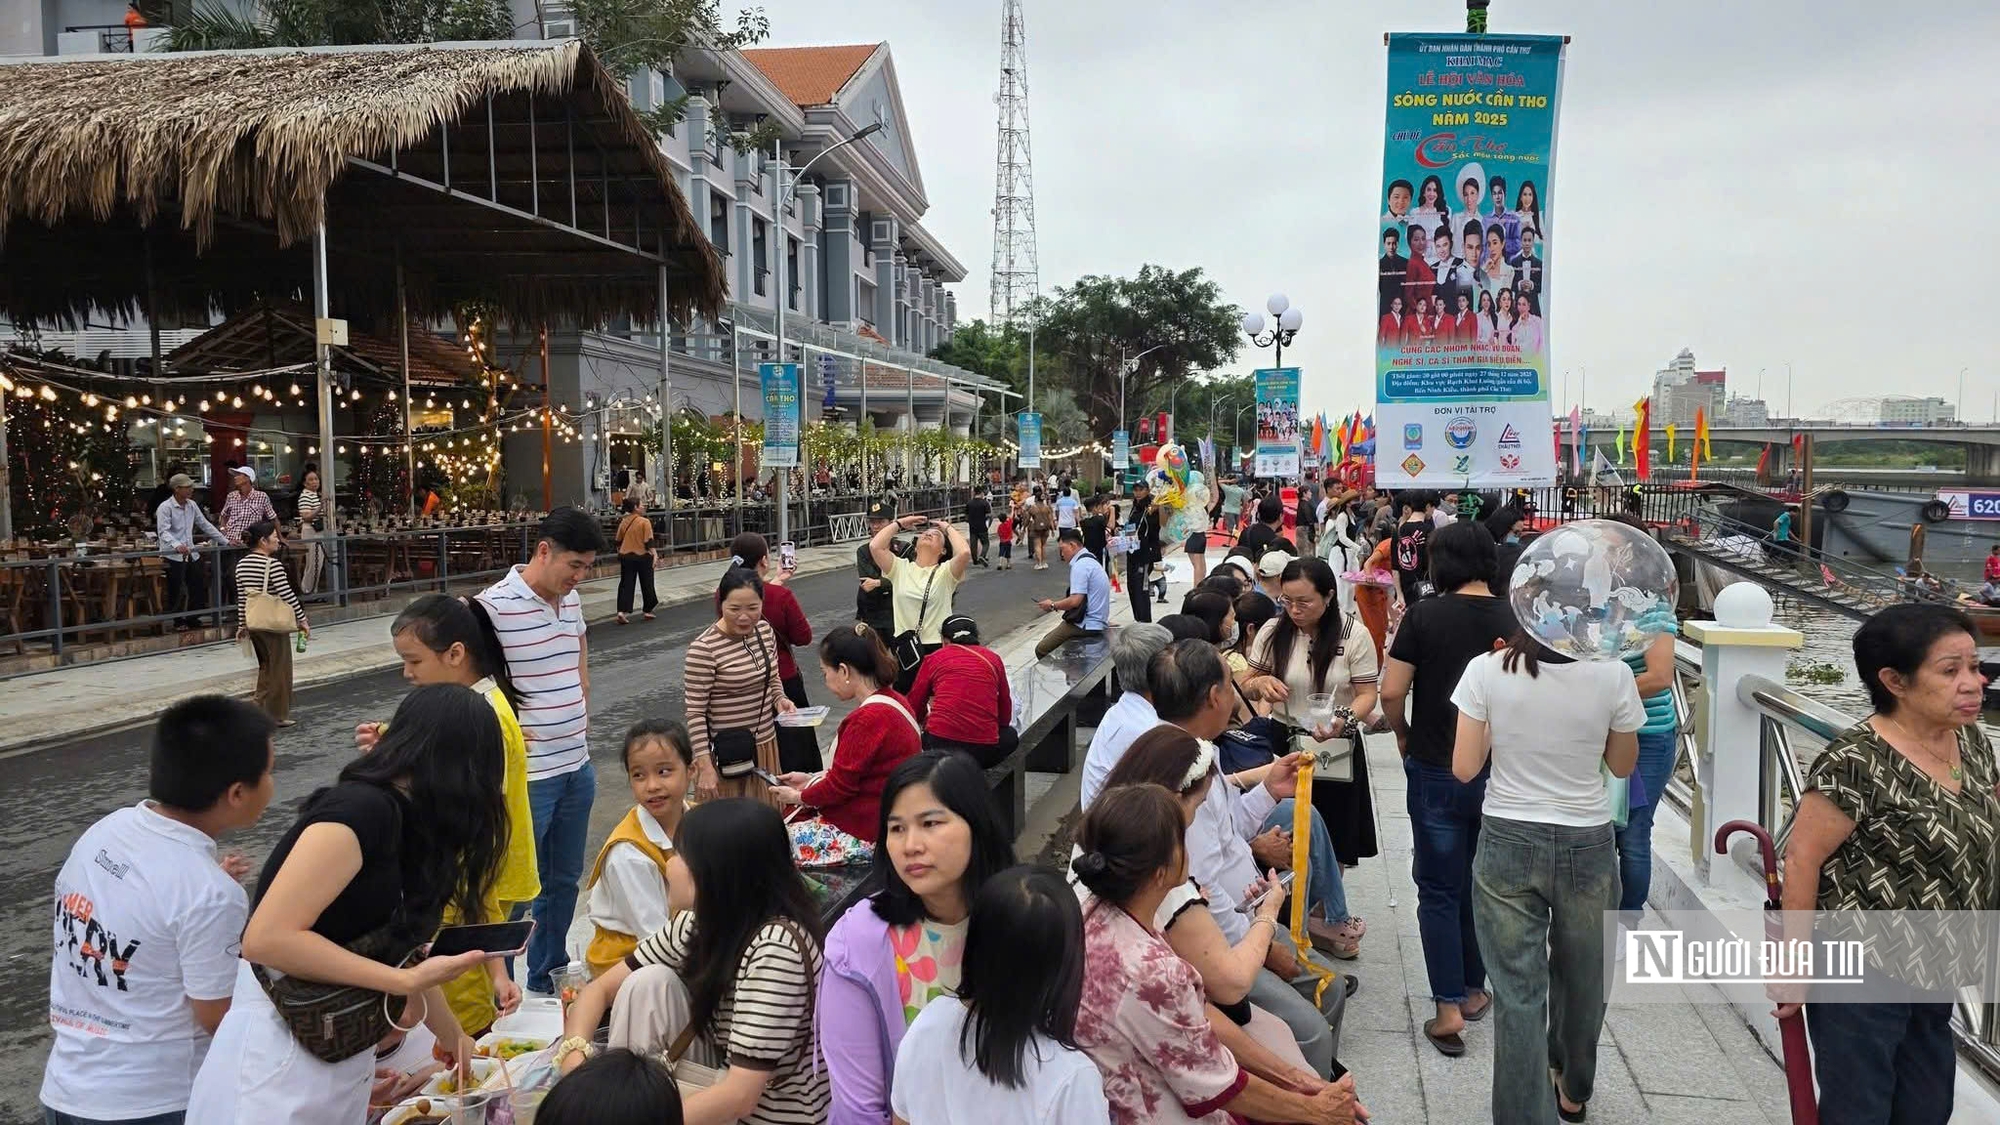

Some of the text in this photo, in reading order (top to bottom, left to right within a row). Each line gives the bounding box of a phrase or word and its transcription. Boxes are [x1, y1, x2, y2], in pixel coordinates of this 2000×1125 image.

[1393, 88, 1548, 108] SÔNG NƯỚC CẦN THƠ
[1432, 111, 1508, 126] NĂM 2025
[1453, 356, 1474, 365] THAM
